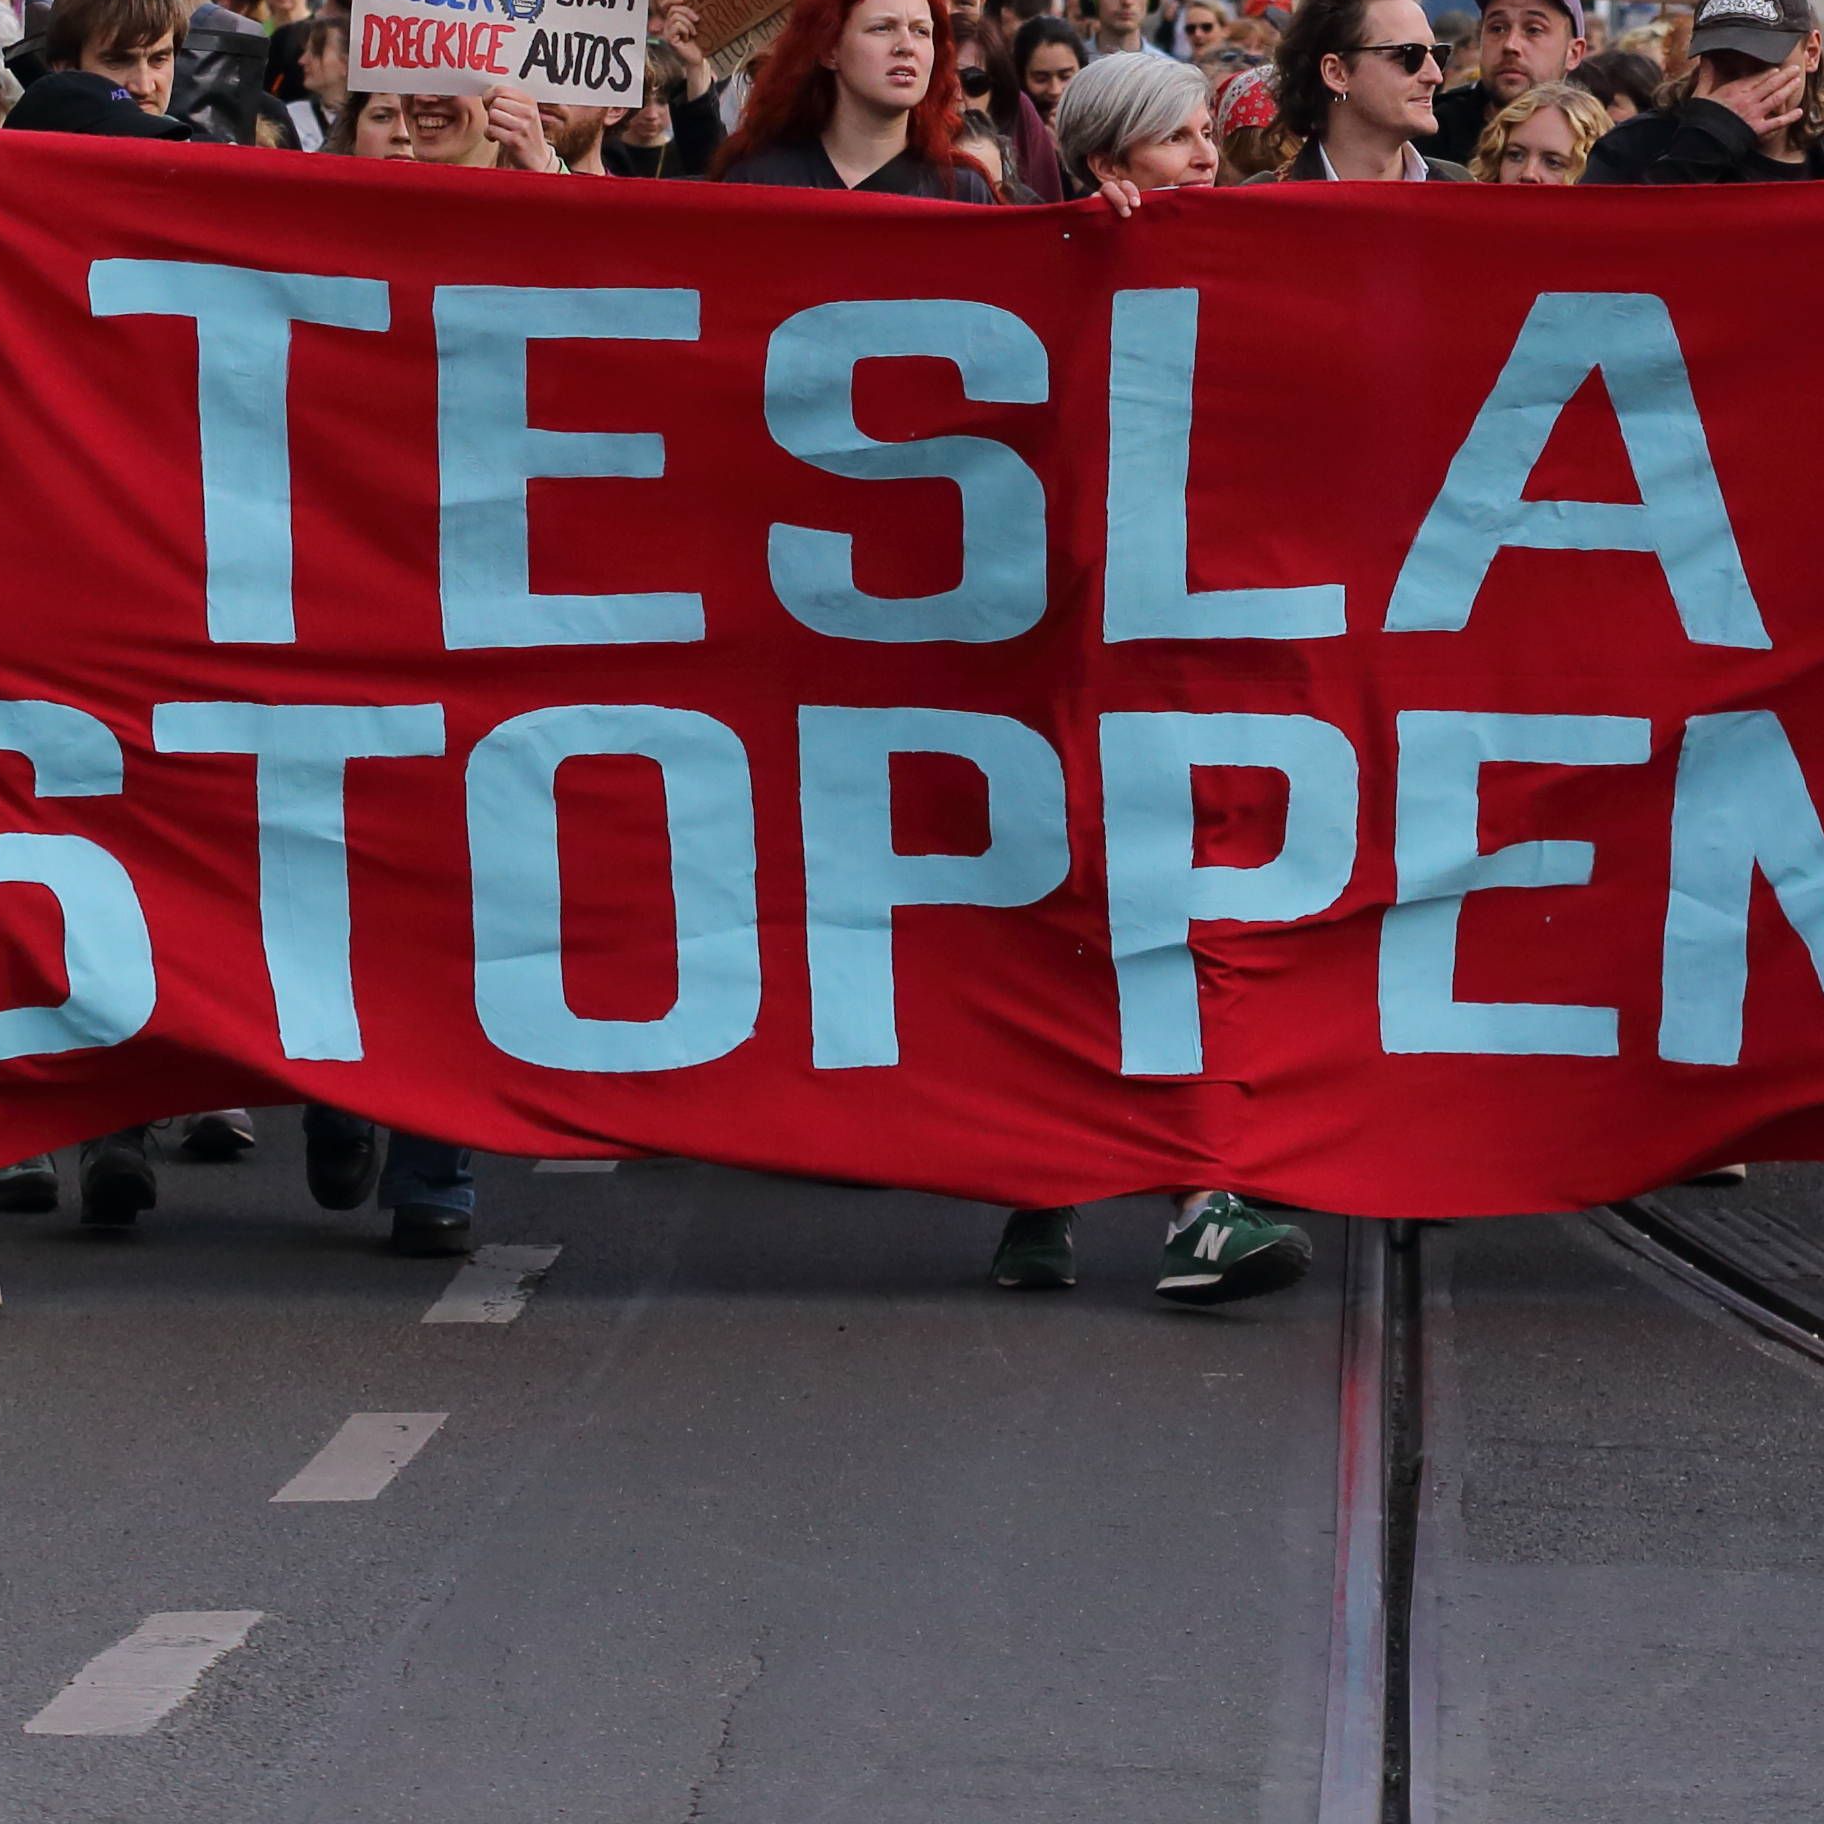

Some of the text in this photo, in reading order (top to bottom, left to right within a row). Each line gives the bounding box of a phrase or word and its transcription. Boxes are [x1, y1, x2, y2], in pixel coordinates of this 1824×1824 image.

[360, 14, 636, 93] DRECKIGE AUTOS
[88, 257, 1772, 650] TESLA
[1193, 1222, 1233, 1262] N
